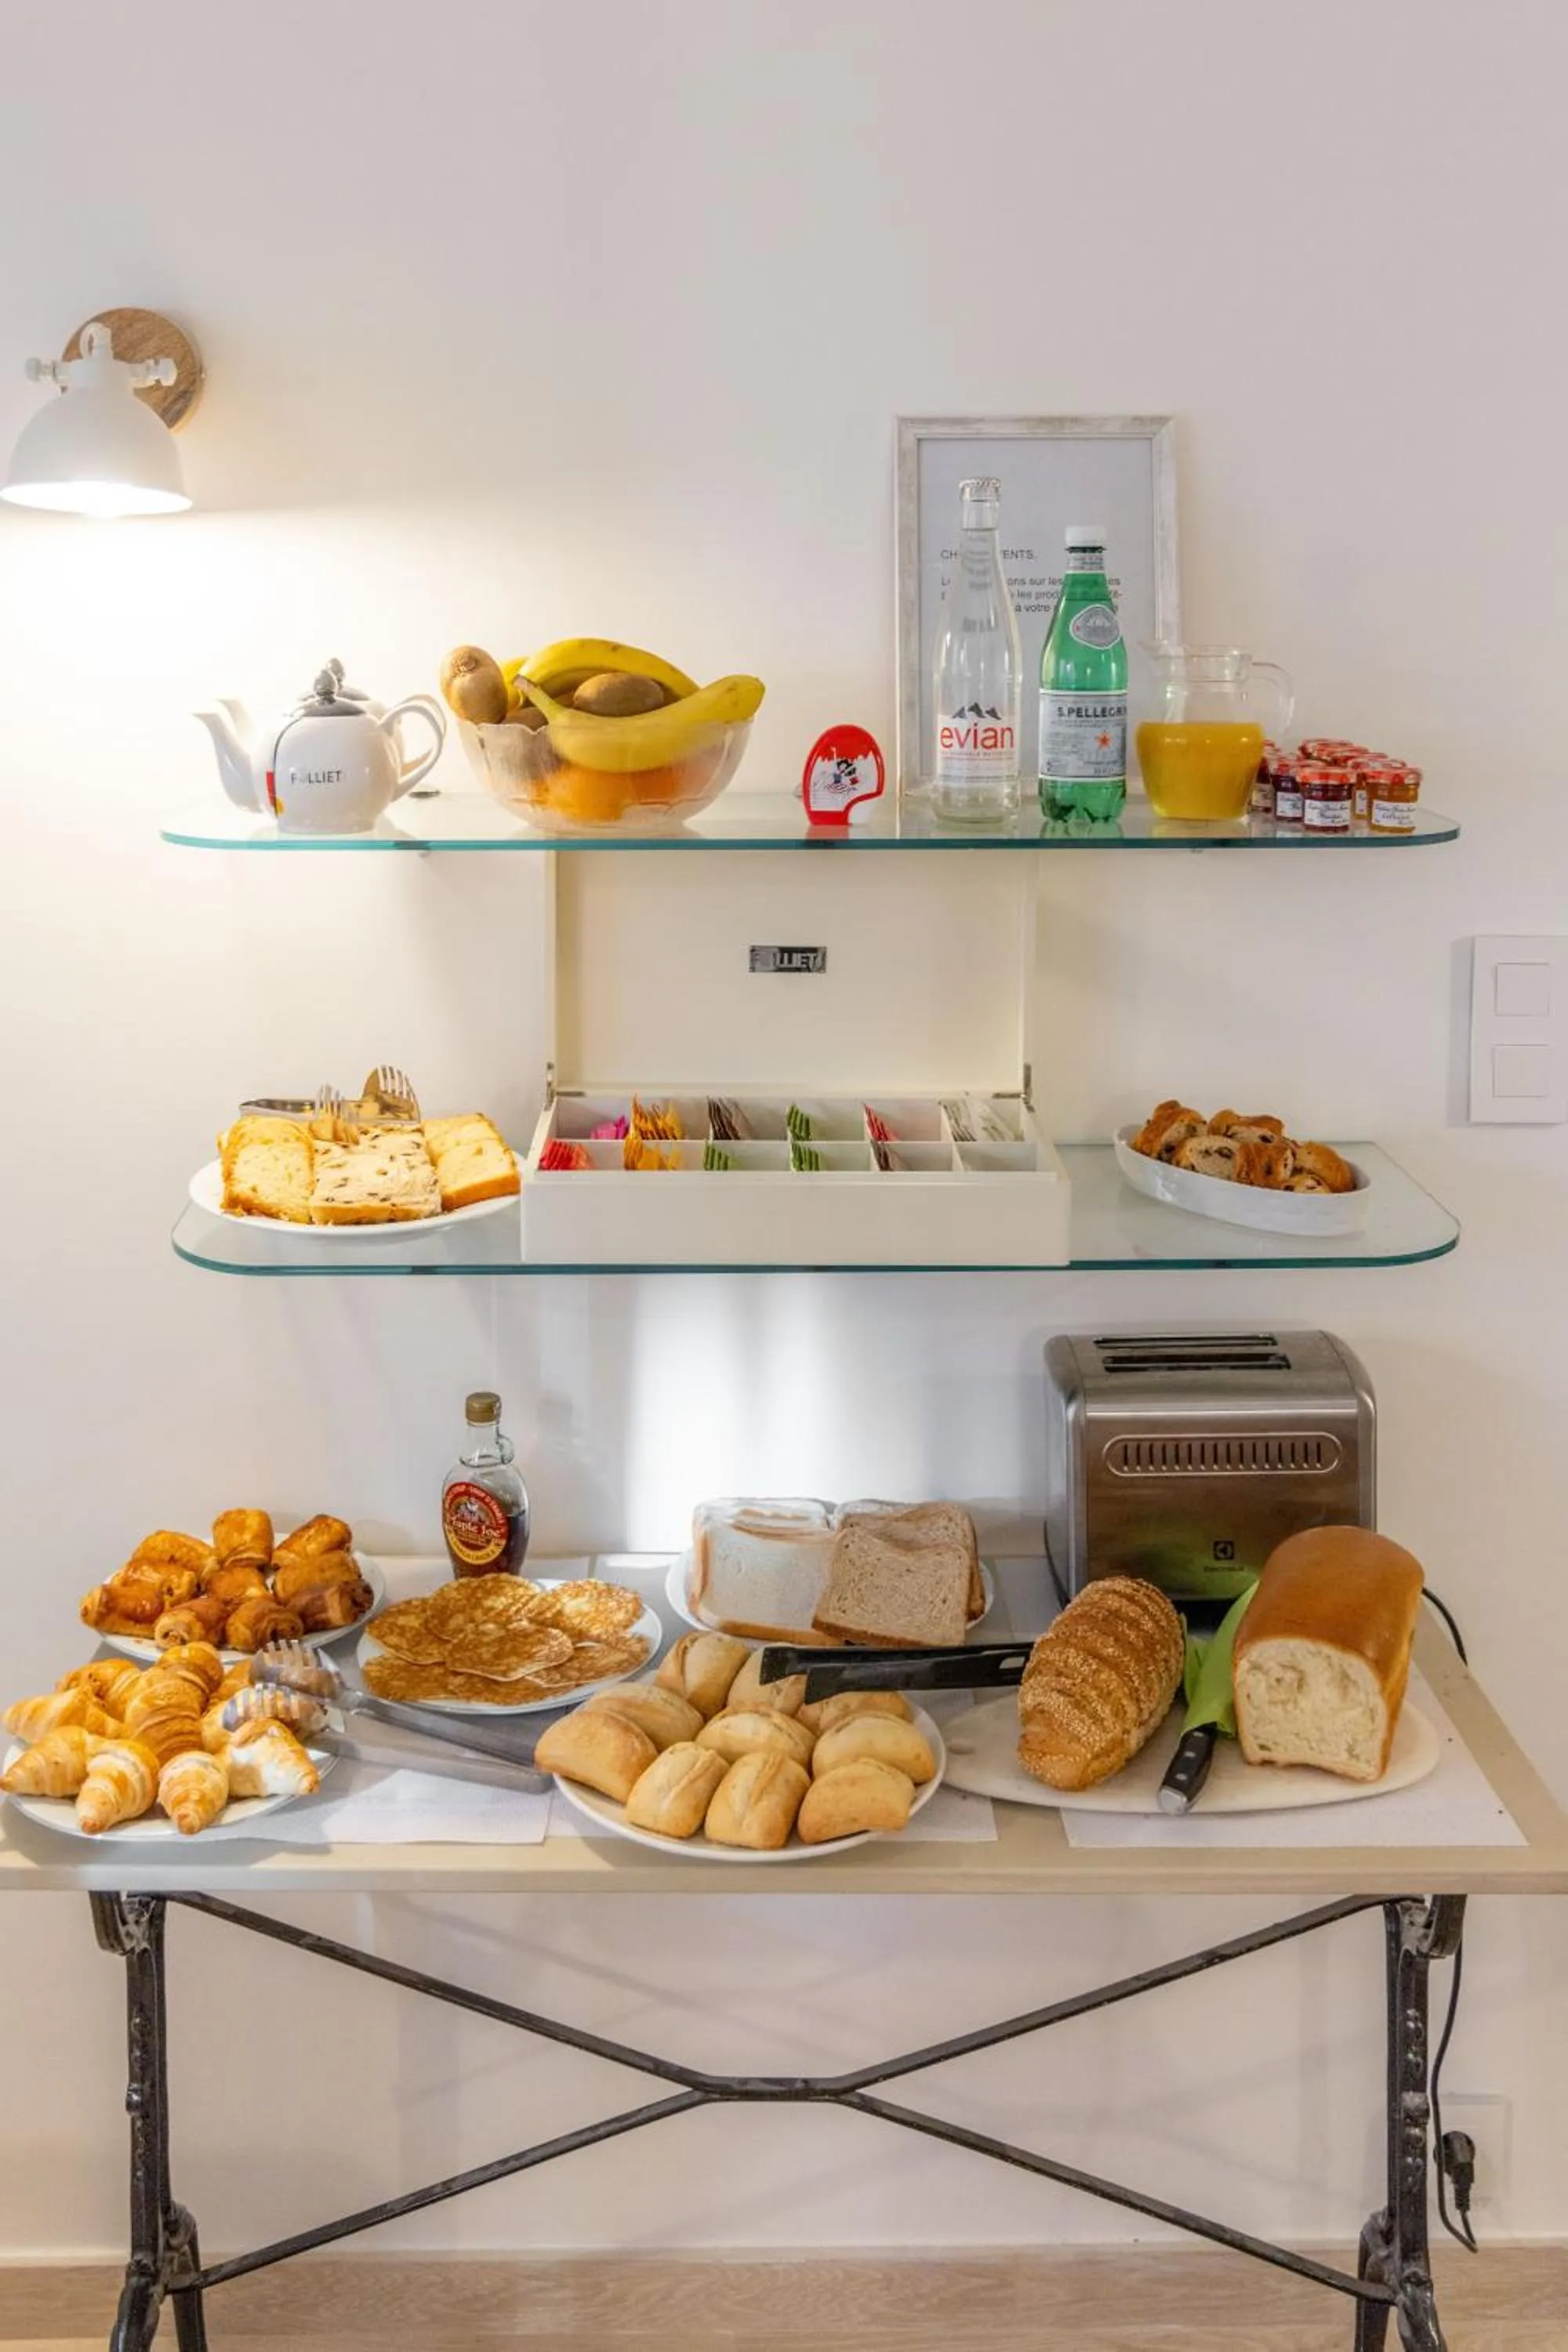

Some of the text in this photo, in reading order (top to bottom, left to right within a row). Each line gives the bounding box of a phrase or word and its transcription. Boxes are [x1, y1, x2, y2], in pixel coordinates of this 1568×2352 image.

[1025, 604, 1051, 612] votre
[940, 722, 1014, 750] evian
[290, 770, 343, 785] FLLIET
